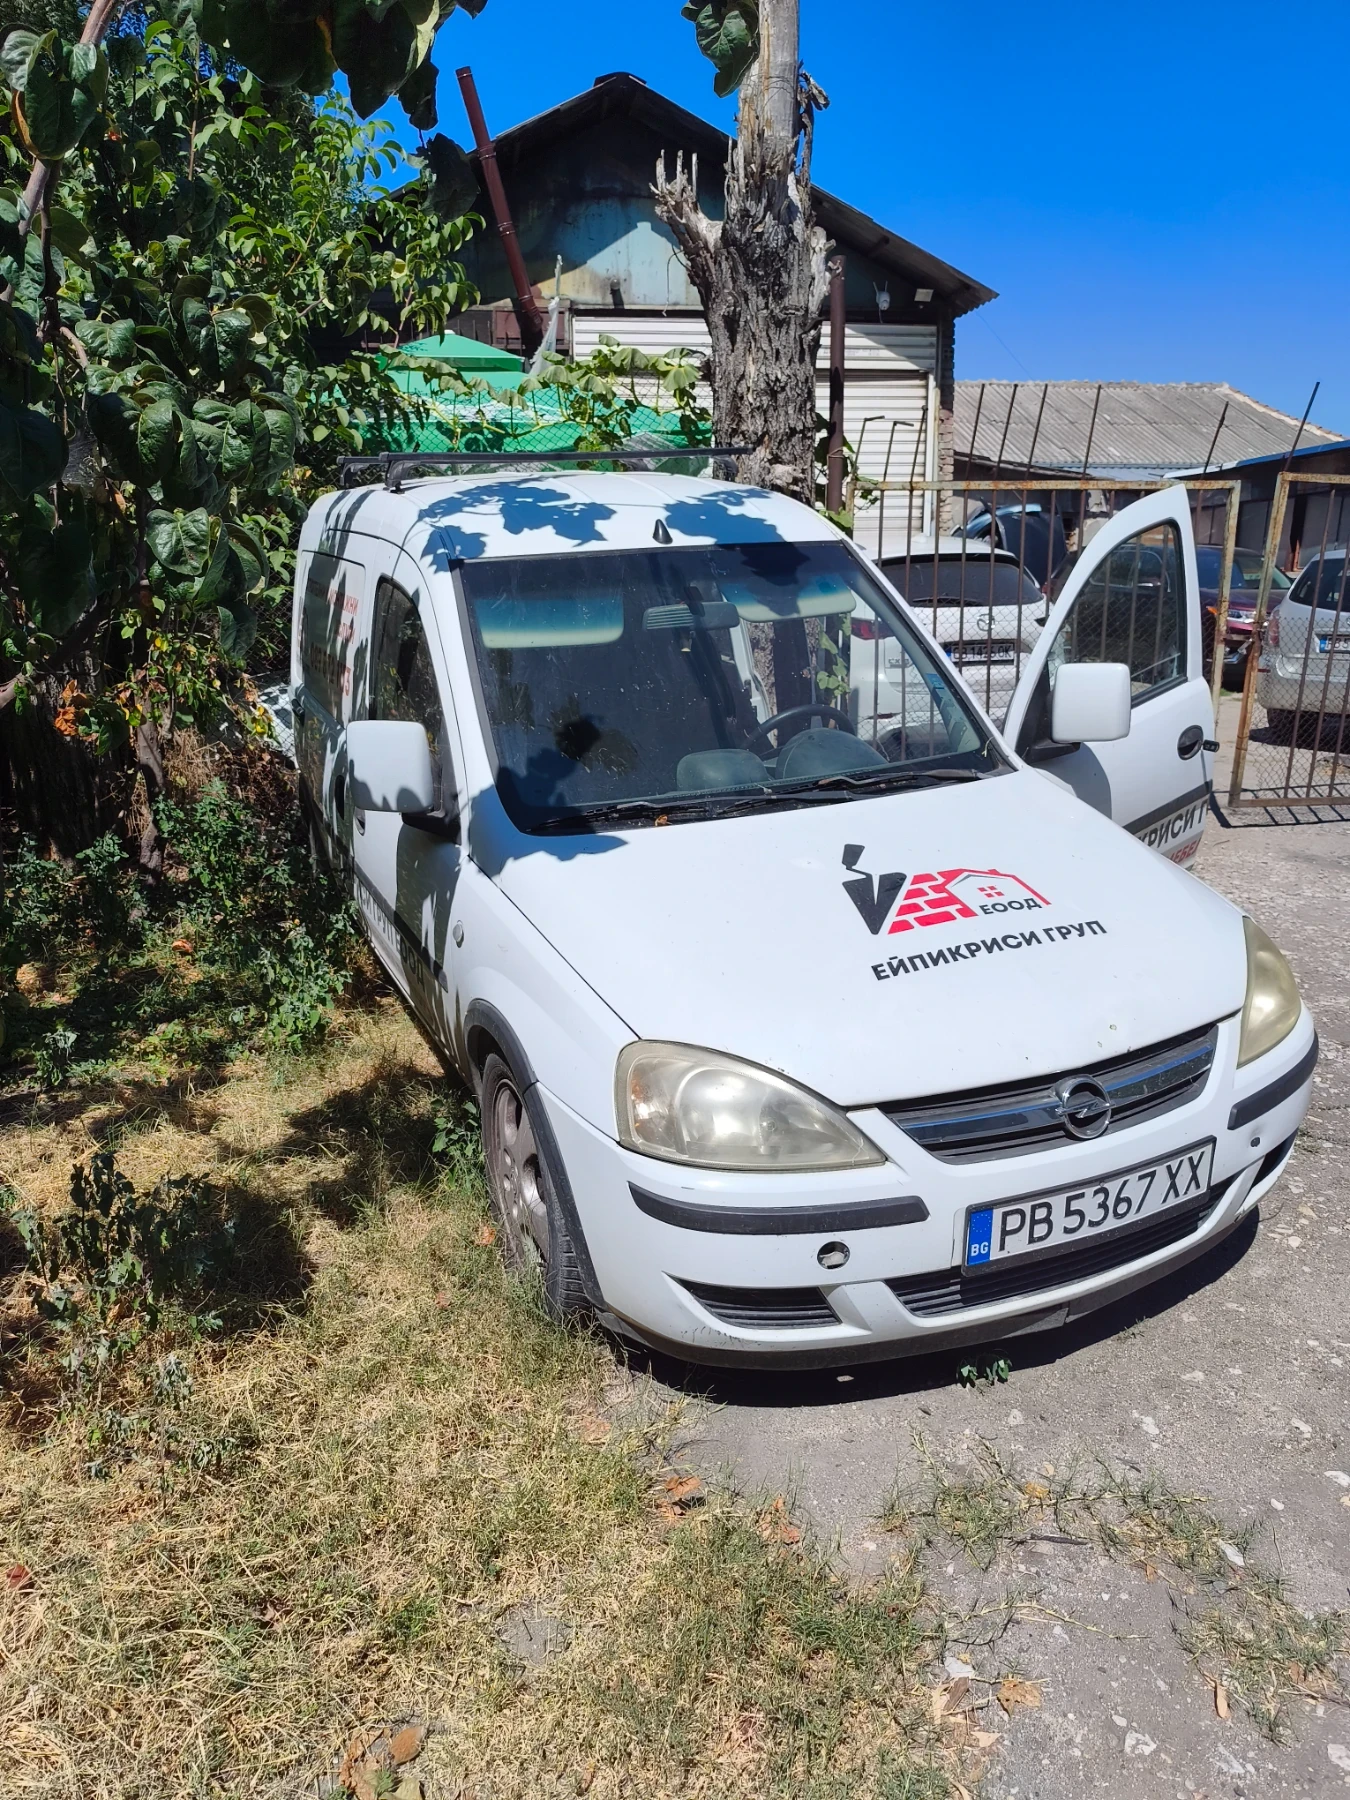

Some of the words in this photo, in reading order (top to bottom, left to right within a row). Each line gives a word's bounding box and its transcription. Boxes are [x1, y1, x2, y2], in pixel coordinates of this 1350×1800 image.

[978, 897, 1042, 915] ЕООД
[871, 930, 1042, 981] ЕЙПИКРИСИ
[1042, 920, 1108, 942] ГРУП
[998, 1201, 1054, 1253] PB
[1063, 1169, 1157, 1235] 5367
[1161, 1151, 1205, 1205] XX
[970, 1242, 989, 1258] BG
